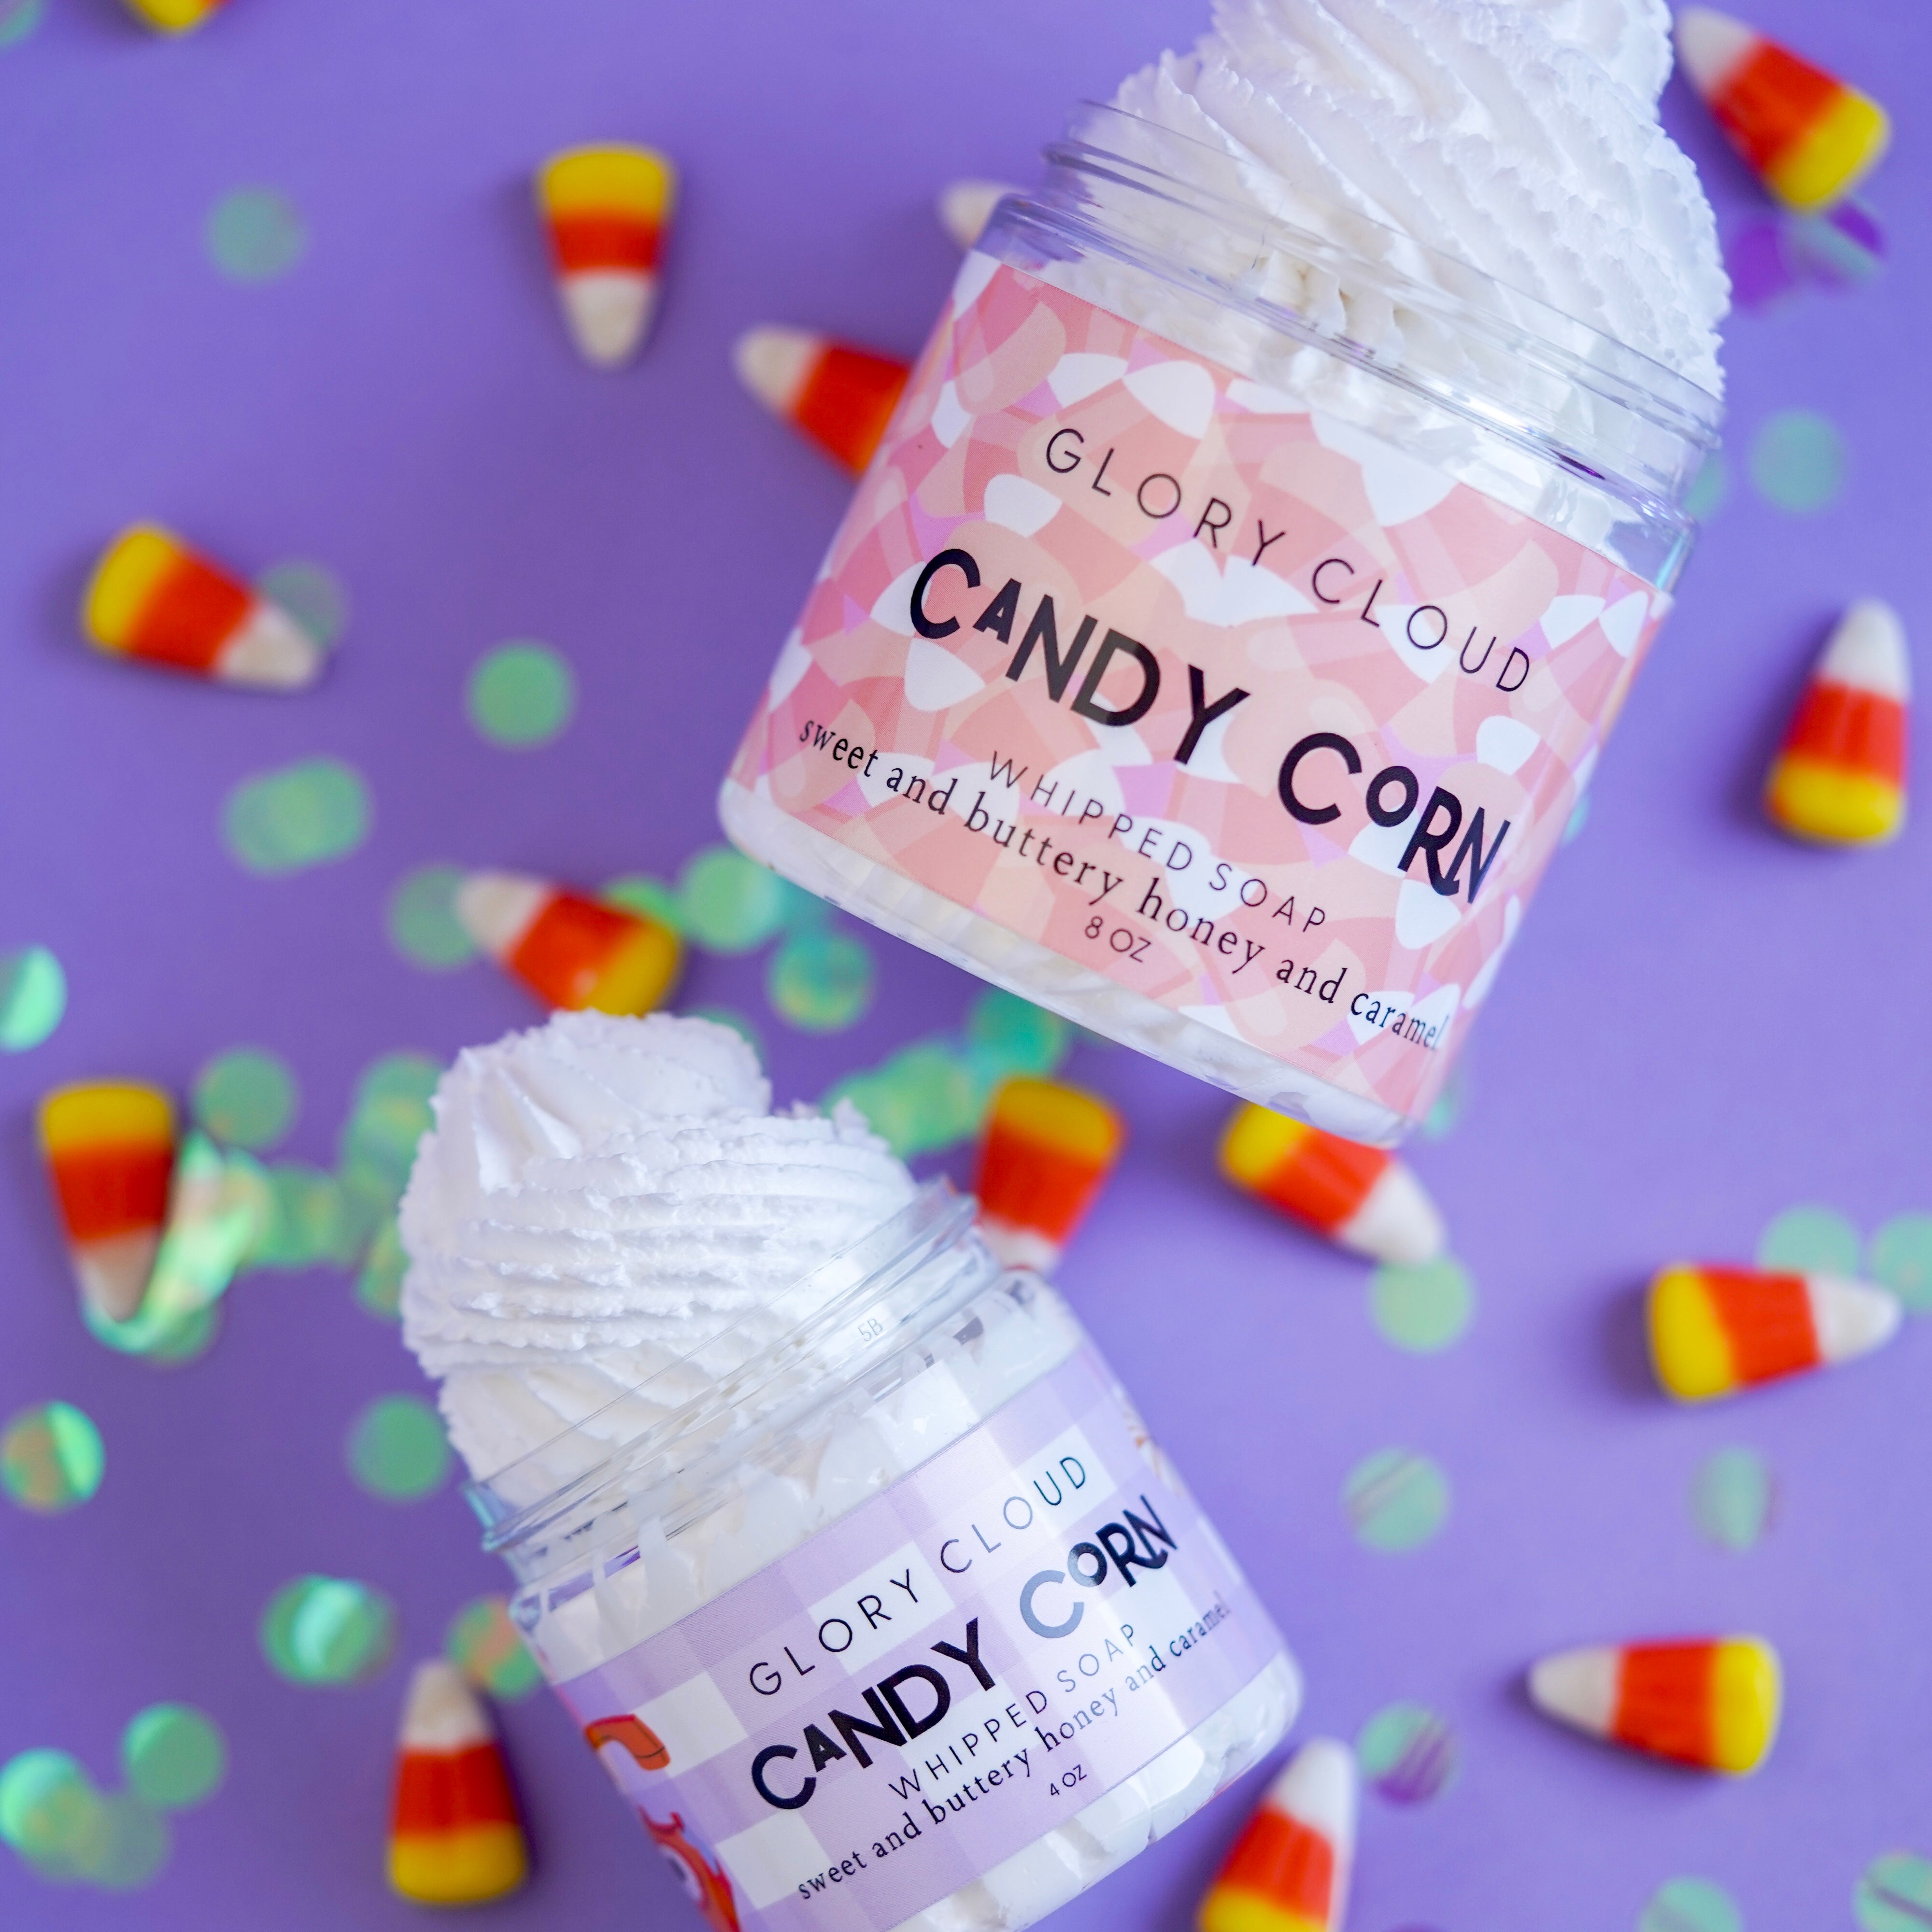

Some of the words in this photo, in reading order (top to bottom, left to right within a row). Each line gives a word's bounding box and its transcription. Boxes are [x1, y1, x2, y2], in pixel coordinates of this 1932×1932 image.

[909, 547, 1250, 766] CANDY
[1045, 428, 1285, 568] GLORY
[1312, 558, 1531, 692] CLOUD
[799, 719, 879, 777] sweet
[886, 766, 957, 816] and
[965, 792, 1123, 906] buttery
[1136, 877, 1266, 975] honey
[1276, 958, 1348, 1004] and
[1350, 992, 1449, 1051] caramel
[987, 751, 1193, 873] WHIPPED
[1209, 862, 1328, 934] SOAP
[1085, 916, 1102, 939] 8
[1110, 928, 1152, 963] OZ
[749, 1569, 926, 1696] GLORY
[939, 1456, 1086, 1574] CLOUD
[750, 1617, 996, 1810] CANDY
[797, 1851, 867, 1900] sweet
[871, 1813, 923, 1858] and
[922, 1747, 1031, 1825] buttery
[1034, 1688, 1119, 1752] honey
[1126, 1646, 1166, 1692] and
[1168, 1589, 1231, 1657] caramel
[888, 1689, 1049, 1800] WHIPPED
[1057, 1623, 1135, 1693] SOAP
[1050, 1782, 1059, 1796] 4
[1062, 1764, 1087, 1791] OZ
